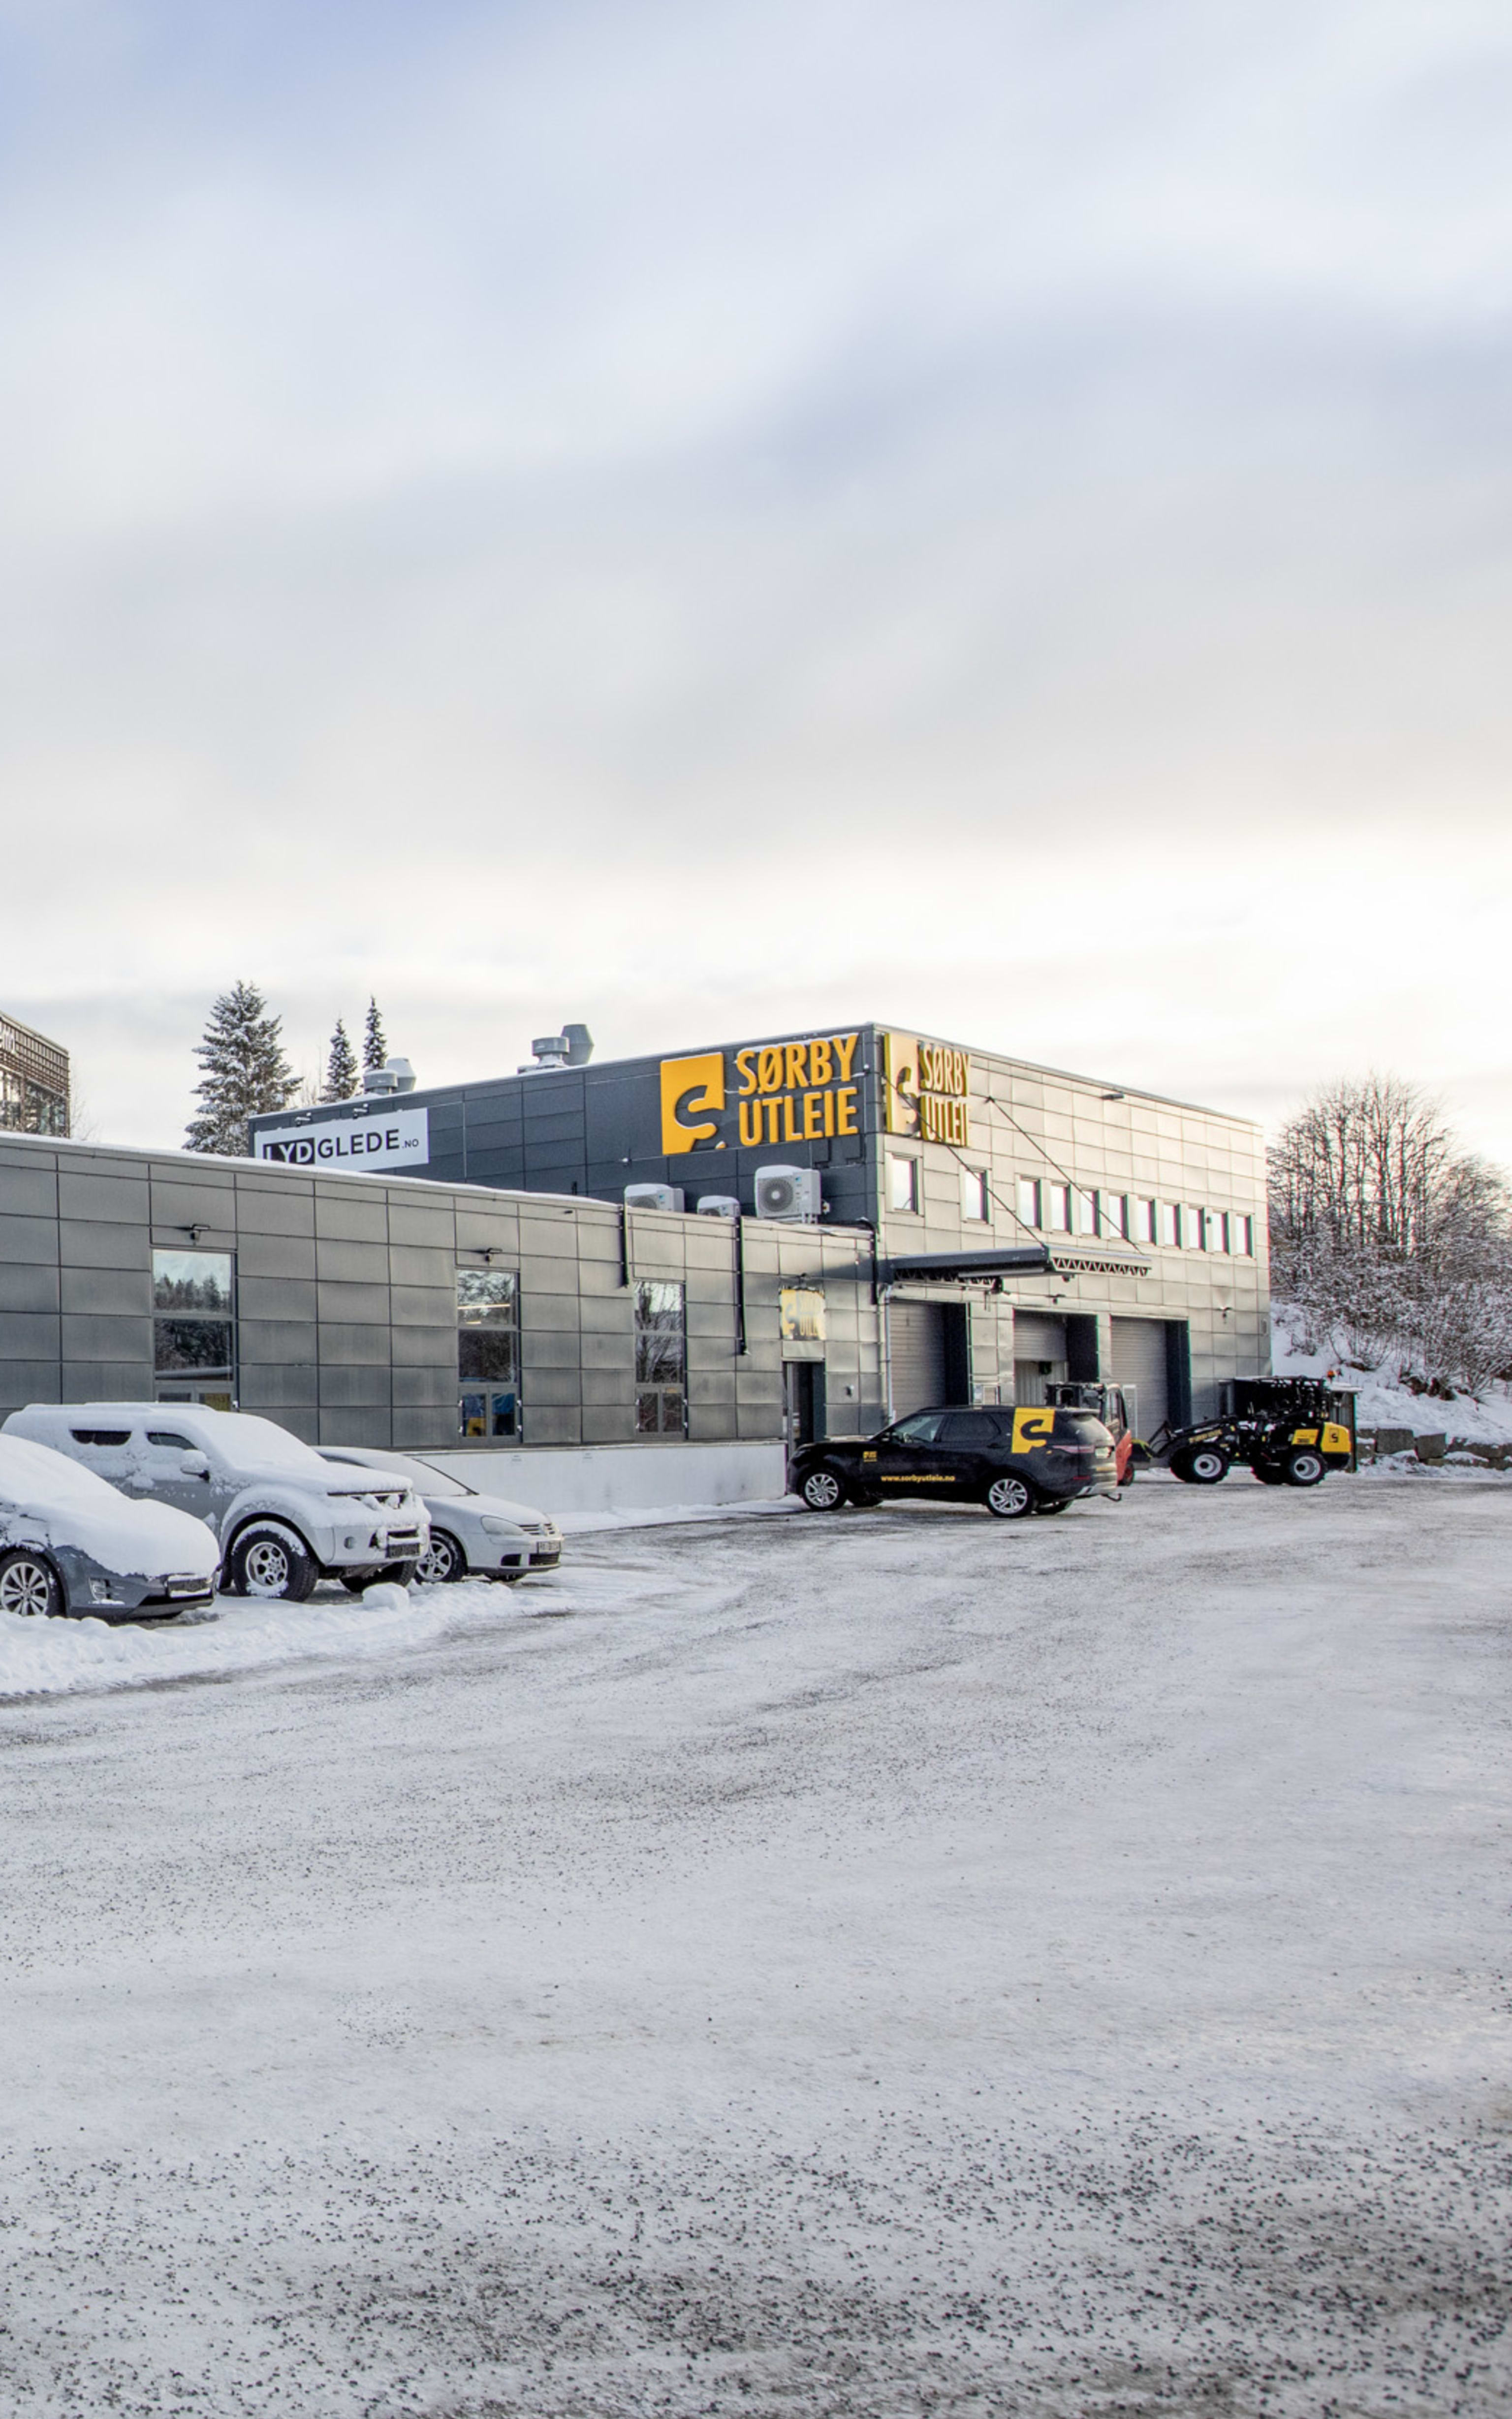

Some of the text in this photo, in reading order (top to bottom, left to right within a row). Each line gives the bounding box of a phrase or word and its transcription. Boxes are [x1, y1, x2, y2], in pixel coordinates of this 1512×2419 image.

[736, 1034, 858, 1096] SØRBY
[919, 1045, 971, 1097] SØRBY
[739, 1088, 858, 1146] UTLEIE
